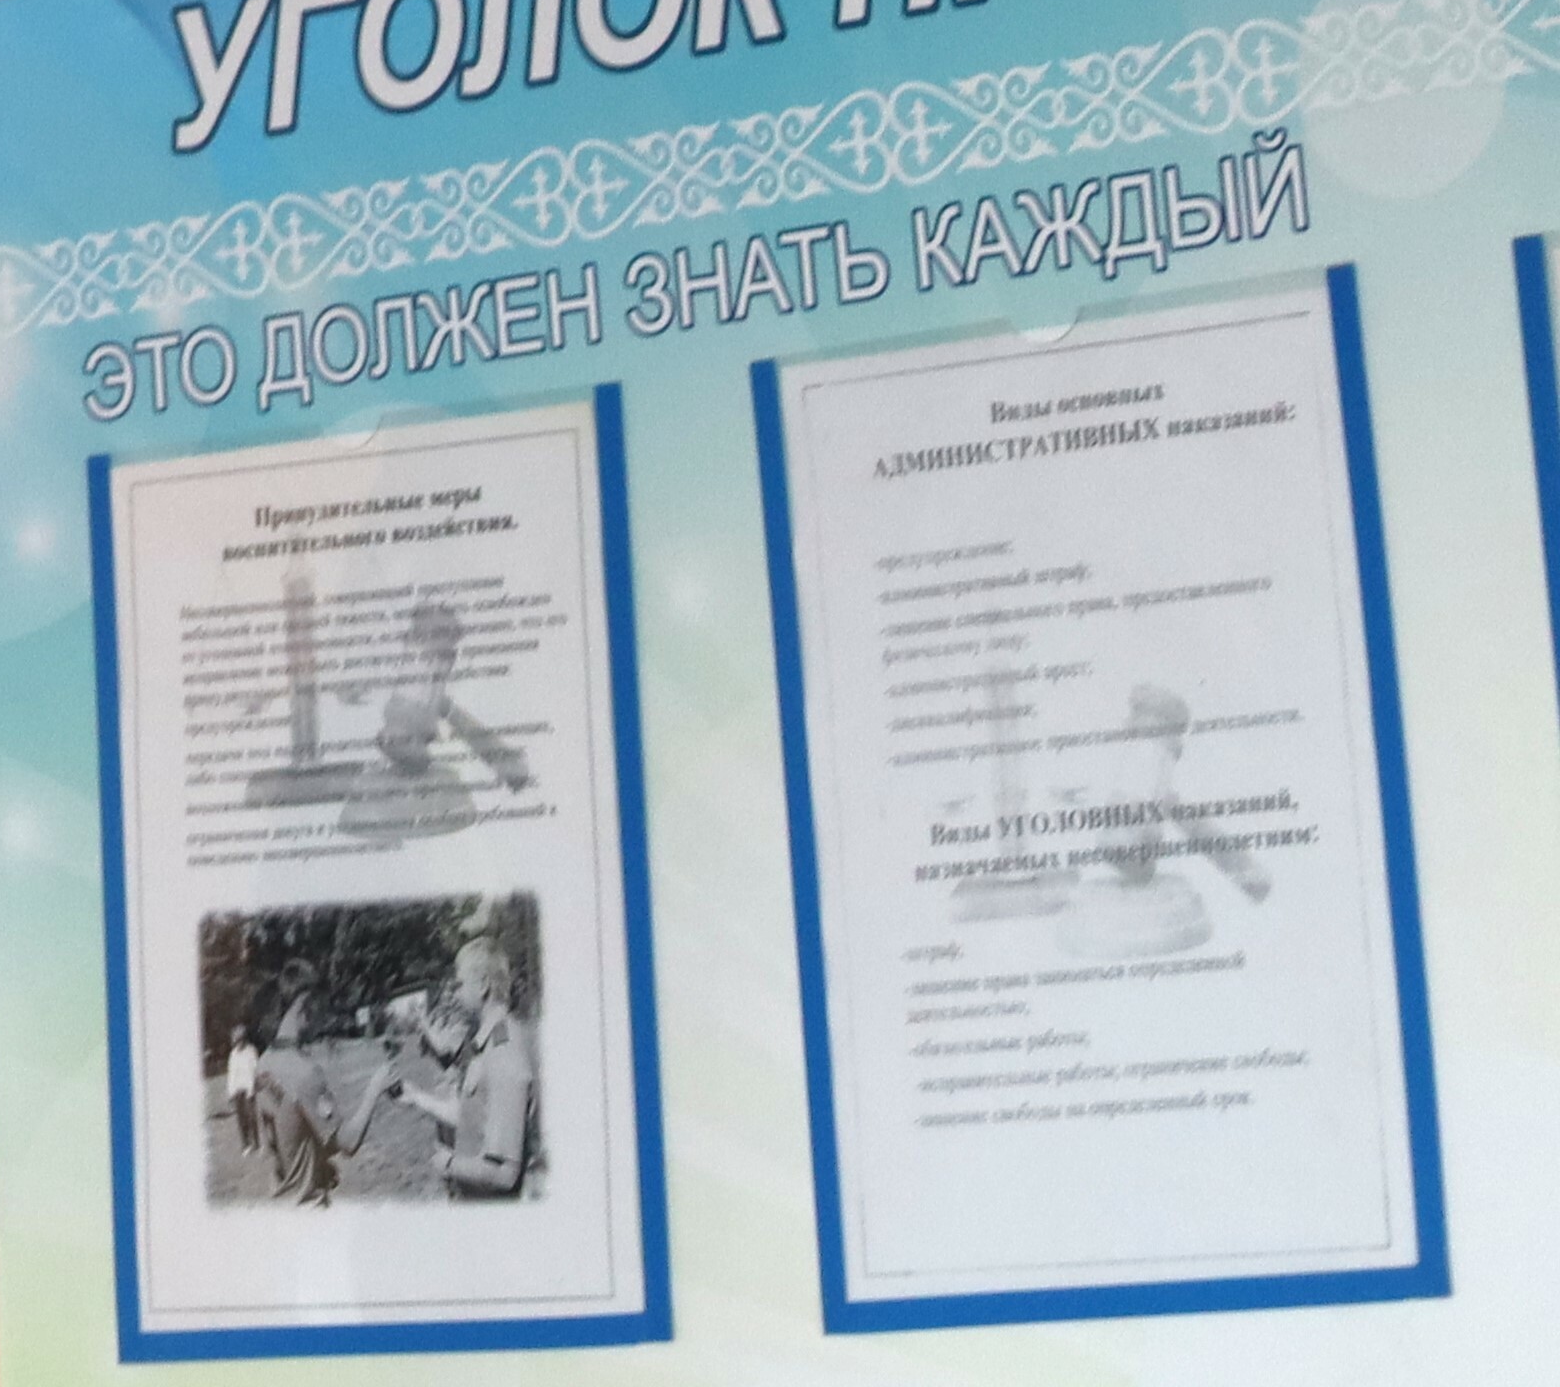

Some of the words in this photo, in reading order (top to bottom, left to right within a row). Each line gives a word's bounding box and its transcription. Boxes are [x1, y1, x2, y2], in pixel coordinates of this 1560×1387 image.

[80, 327, 237, 421] ЭТО
[256, 263, 601, 407] ДОЛЖЕН
[624, 221, 888, 338] ЗНАТЬ
[910, 127, 1312, 291] КАЖДЫЙ
[989, 399, 1051, 426] Виды
[1056, 383, 1166, 415] основных
[872, 416, 1160, 480] АДМИНИСТРАТИВНЫХ
[254, 495, 425, 531] Принудительные
[929, 822, 991, 847] Виды
[997, 799, 1166, 839] УГОЛОВНЫХ
